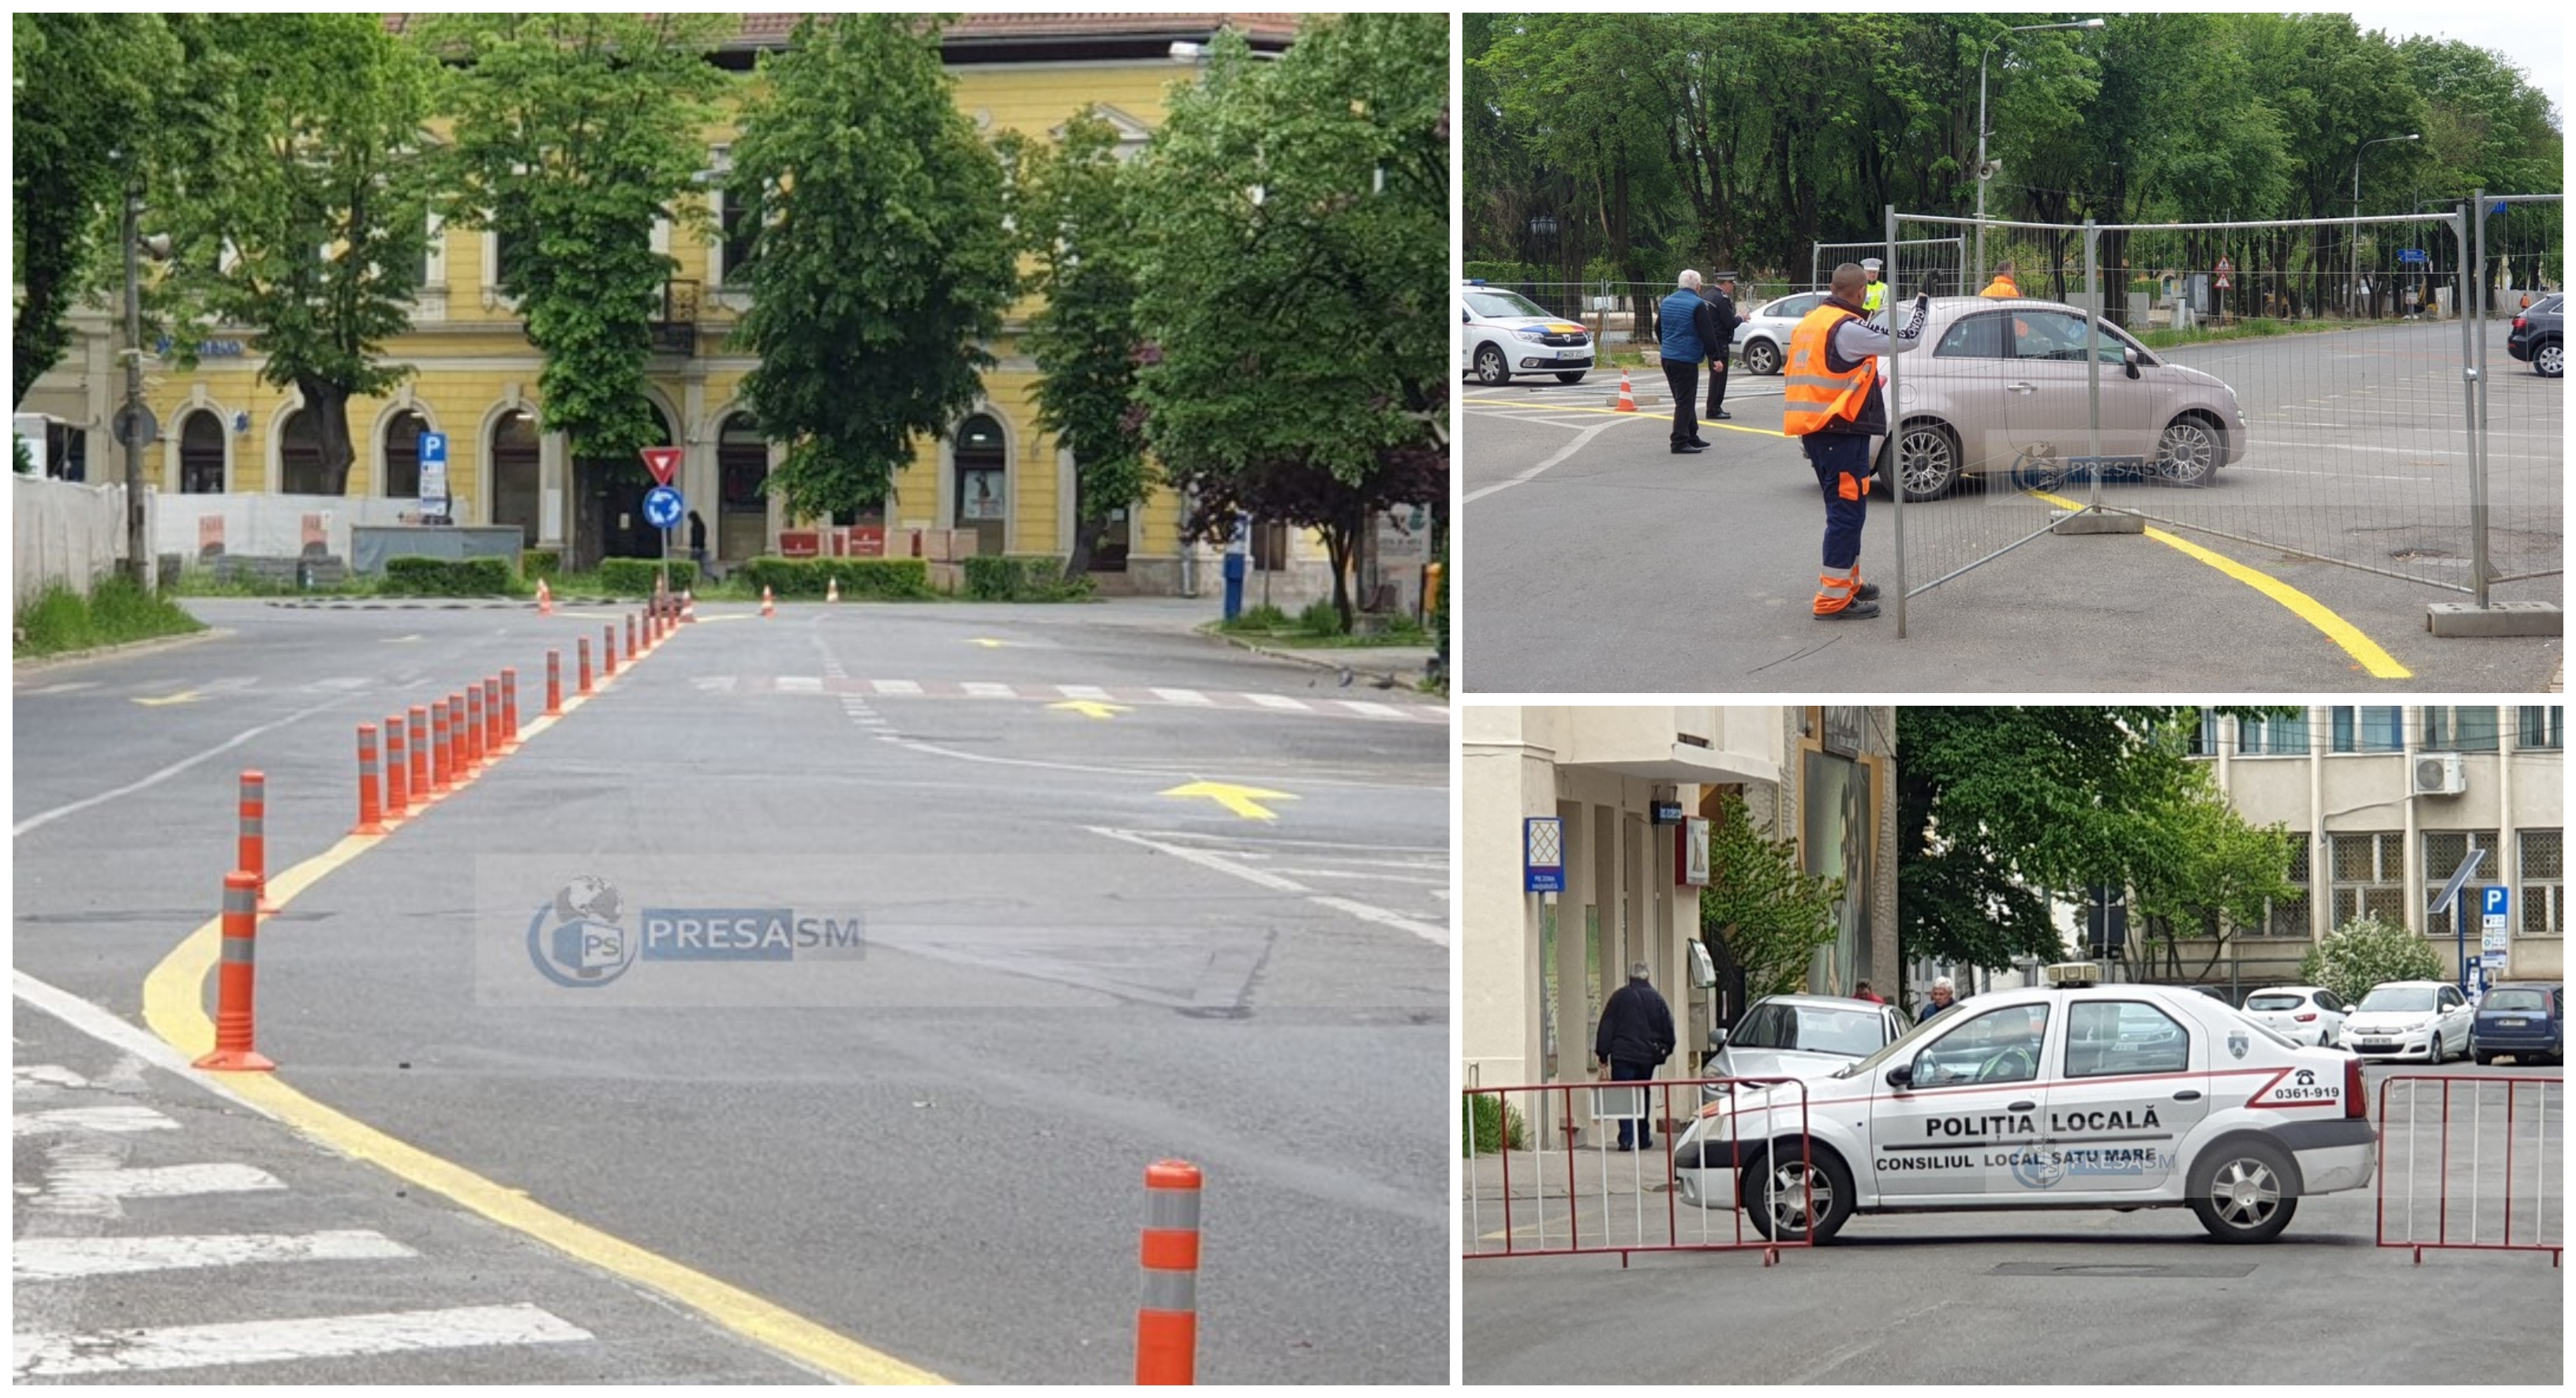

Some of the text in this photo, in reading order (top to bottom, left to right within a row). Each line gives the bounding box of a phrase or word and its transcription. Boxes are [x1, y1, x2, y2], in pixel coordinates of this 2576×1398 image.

[425, 436, 441, 458] P
[2487, 890, 2502, 911] P
[2275, 1087, 2340, 1099] 0361-919
[2052, 1105, 2160, 1132] LOCALĂ
[1876, 1155, 1975, 1171] CONSILIUL
[1984, 1152, 2043, 1167] LOCAL
